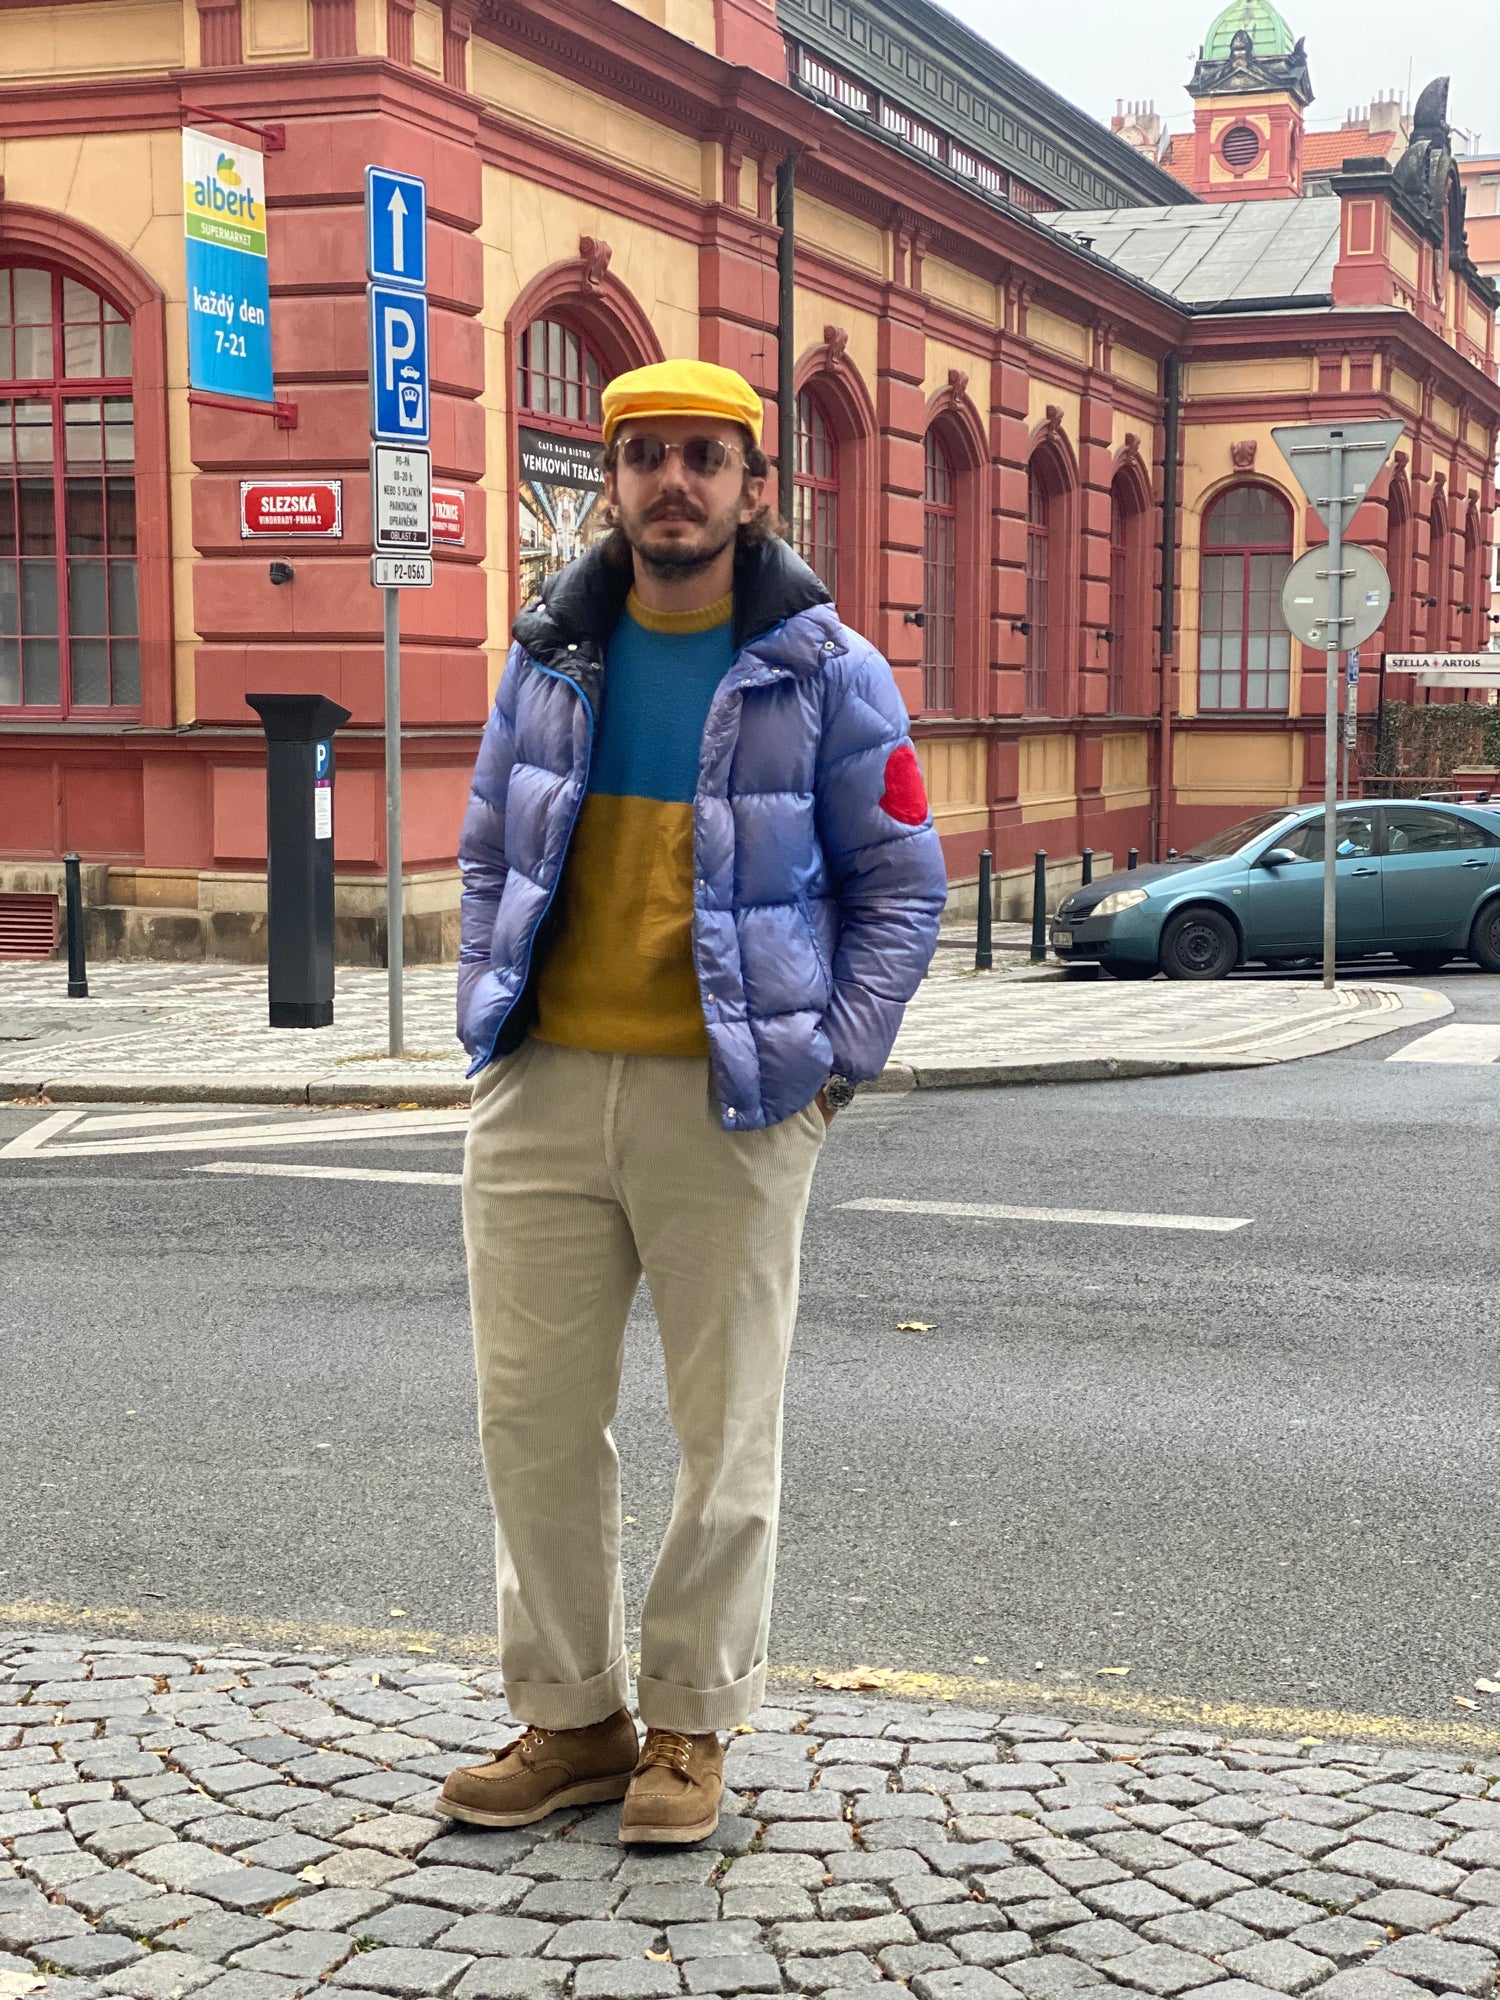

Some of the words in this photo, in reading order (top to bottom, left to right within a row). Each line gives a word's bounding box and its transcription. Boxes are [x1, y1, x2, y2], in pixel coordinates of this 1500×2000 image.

[194, 174, 256, 221] albert
[201, 222, 252, 246] SUPERMARKET
[193, 286, 234, 325] každý
[240, 298, 265, 326] den
[215, 330, 247, 358] 7-21
[384, 306, 416, 391] P
[555, 444, 567, 454] BAR
[569, 447, 591, 459] BISTRO
[523, 453, 570, 477] VENKOVNÍ
[572, 463, 606, 484] TERASA
[383, 485, 396, 496] NEBO
[397, 486, 402, 496] S
[402, 485, 423, 497] PLATNÝM
[261, 493, 317, 512] SLEZSKÁ
[316, 515, 322, 525] 2
[390, 531, 411, 541] OBLAST
[412, 532, 417, 541] 2
[394, 564, 425, 580] P2-0563
[1392, 659, 1430, 667] STELLA
[1442, 659, 1481, 667] ARTOIS
[316, 744, 326, 772] P
